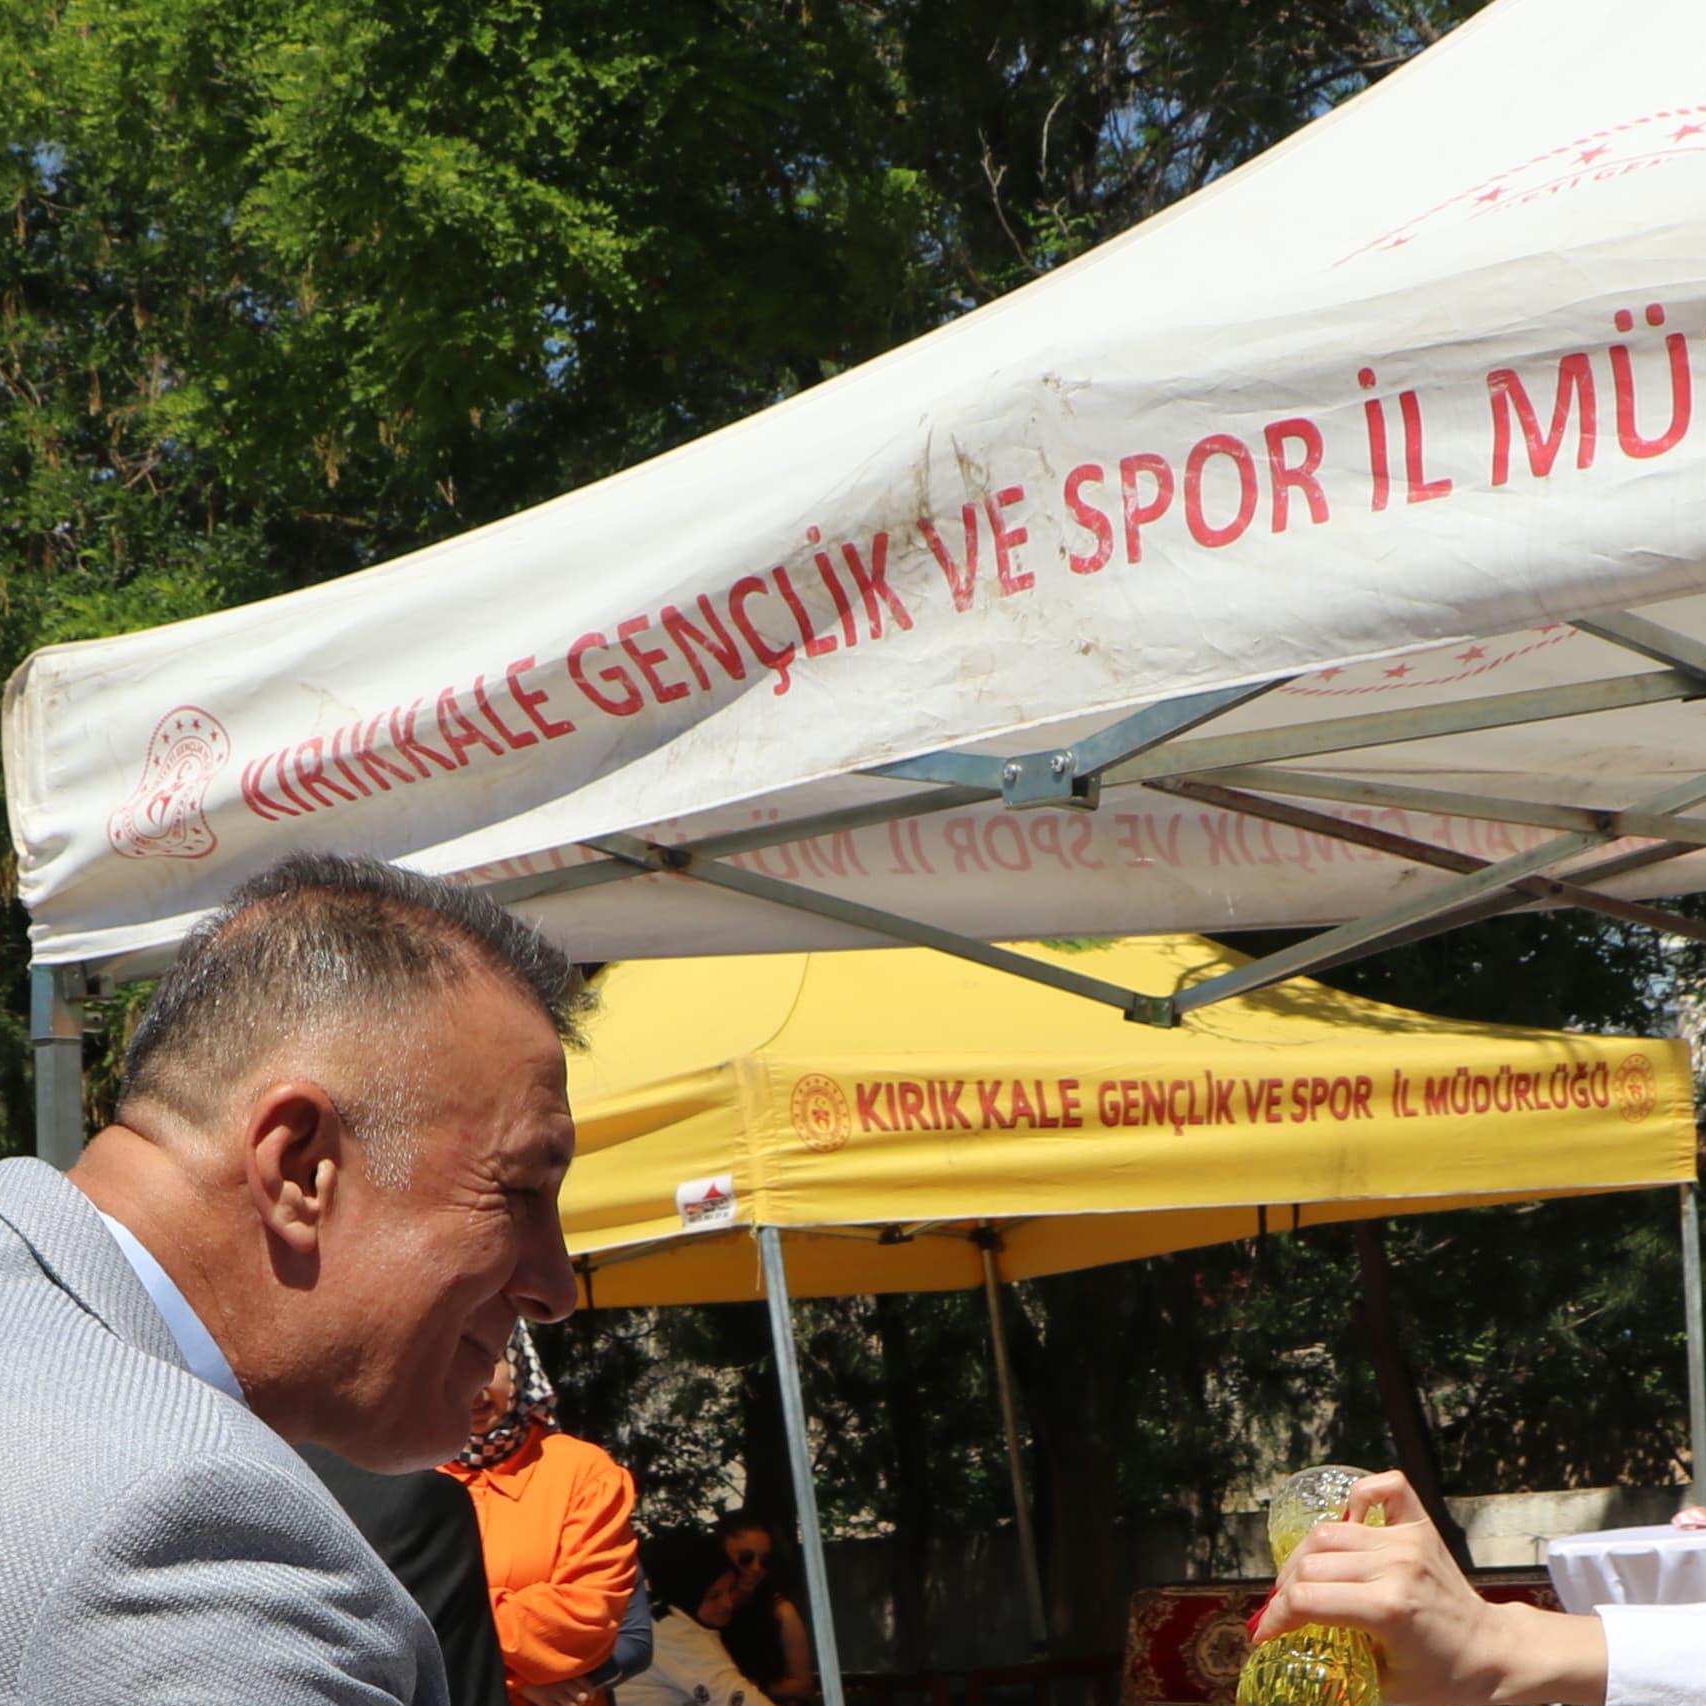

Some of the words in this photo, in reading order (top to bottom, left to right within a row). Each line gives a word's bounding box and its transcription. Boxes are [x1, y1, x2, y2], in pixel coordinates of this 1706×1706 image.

[241, 656, 575, 821] KIRIKKALE
[567, 525, 913, 718] GENÇLİK
[917, 484, 1036, 612] VE
[1063, 416, 1331, 575] SPOR
[1357, 366, 1454, 513] İL
[1098, 1069, 1235, 1136] GENÇLİK
[1243, 1077, 1284, 1124] VE
[1290, 1075, 1374, 1122] SPOR
[1392, 1068, 1416, 1117] İL
[1424, 1061, 1611, 1117] MÜDÜRLÜĞÜ
